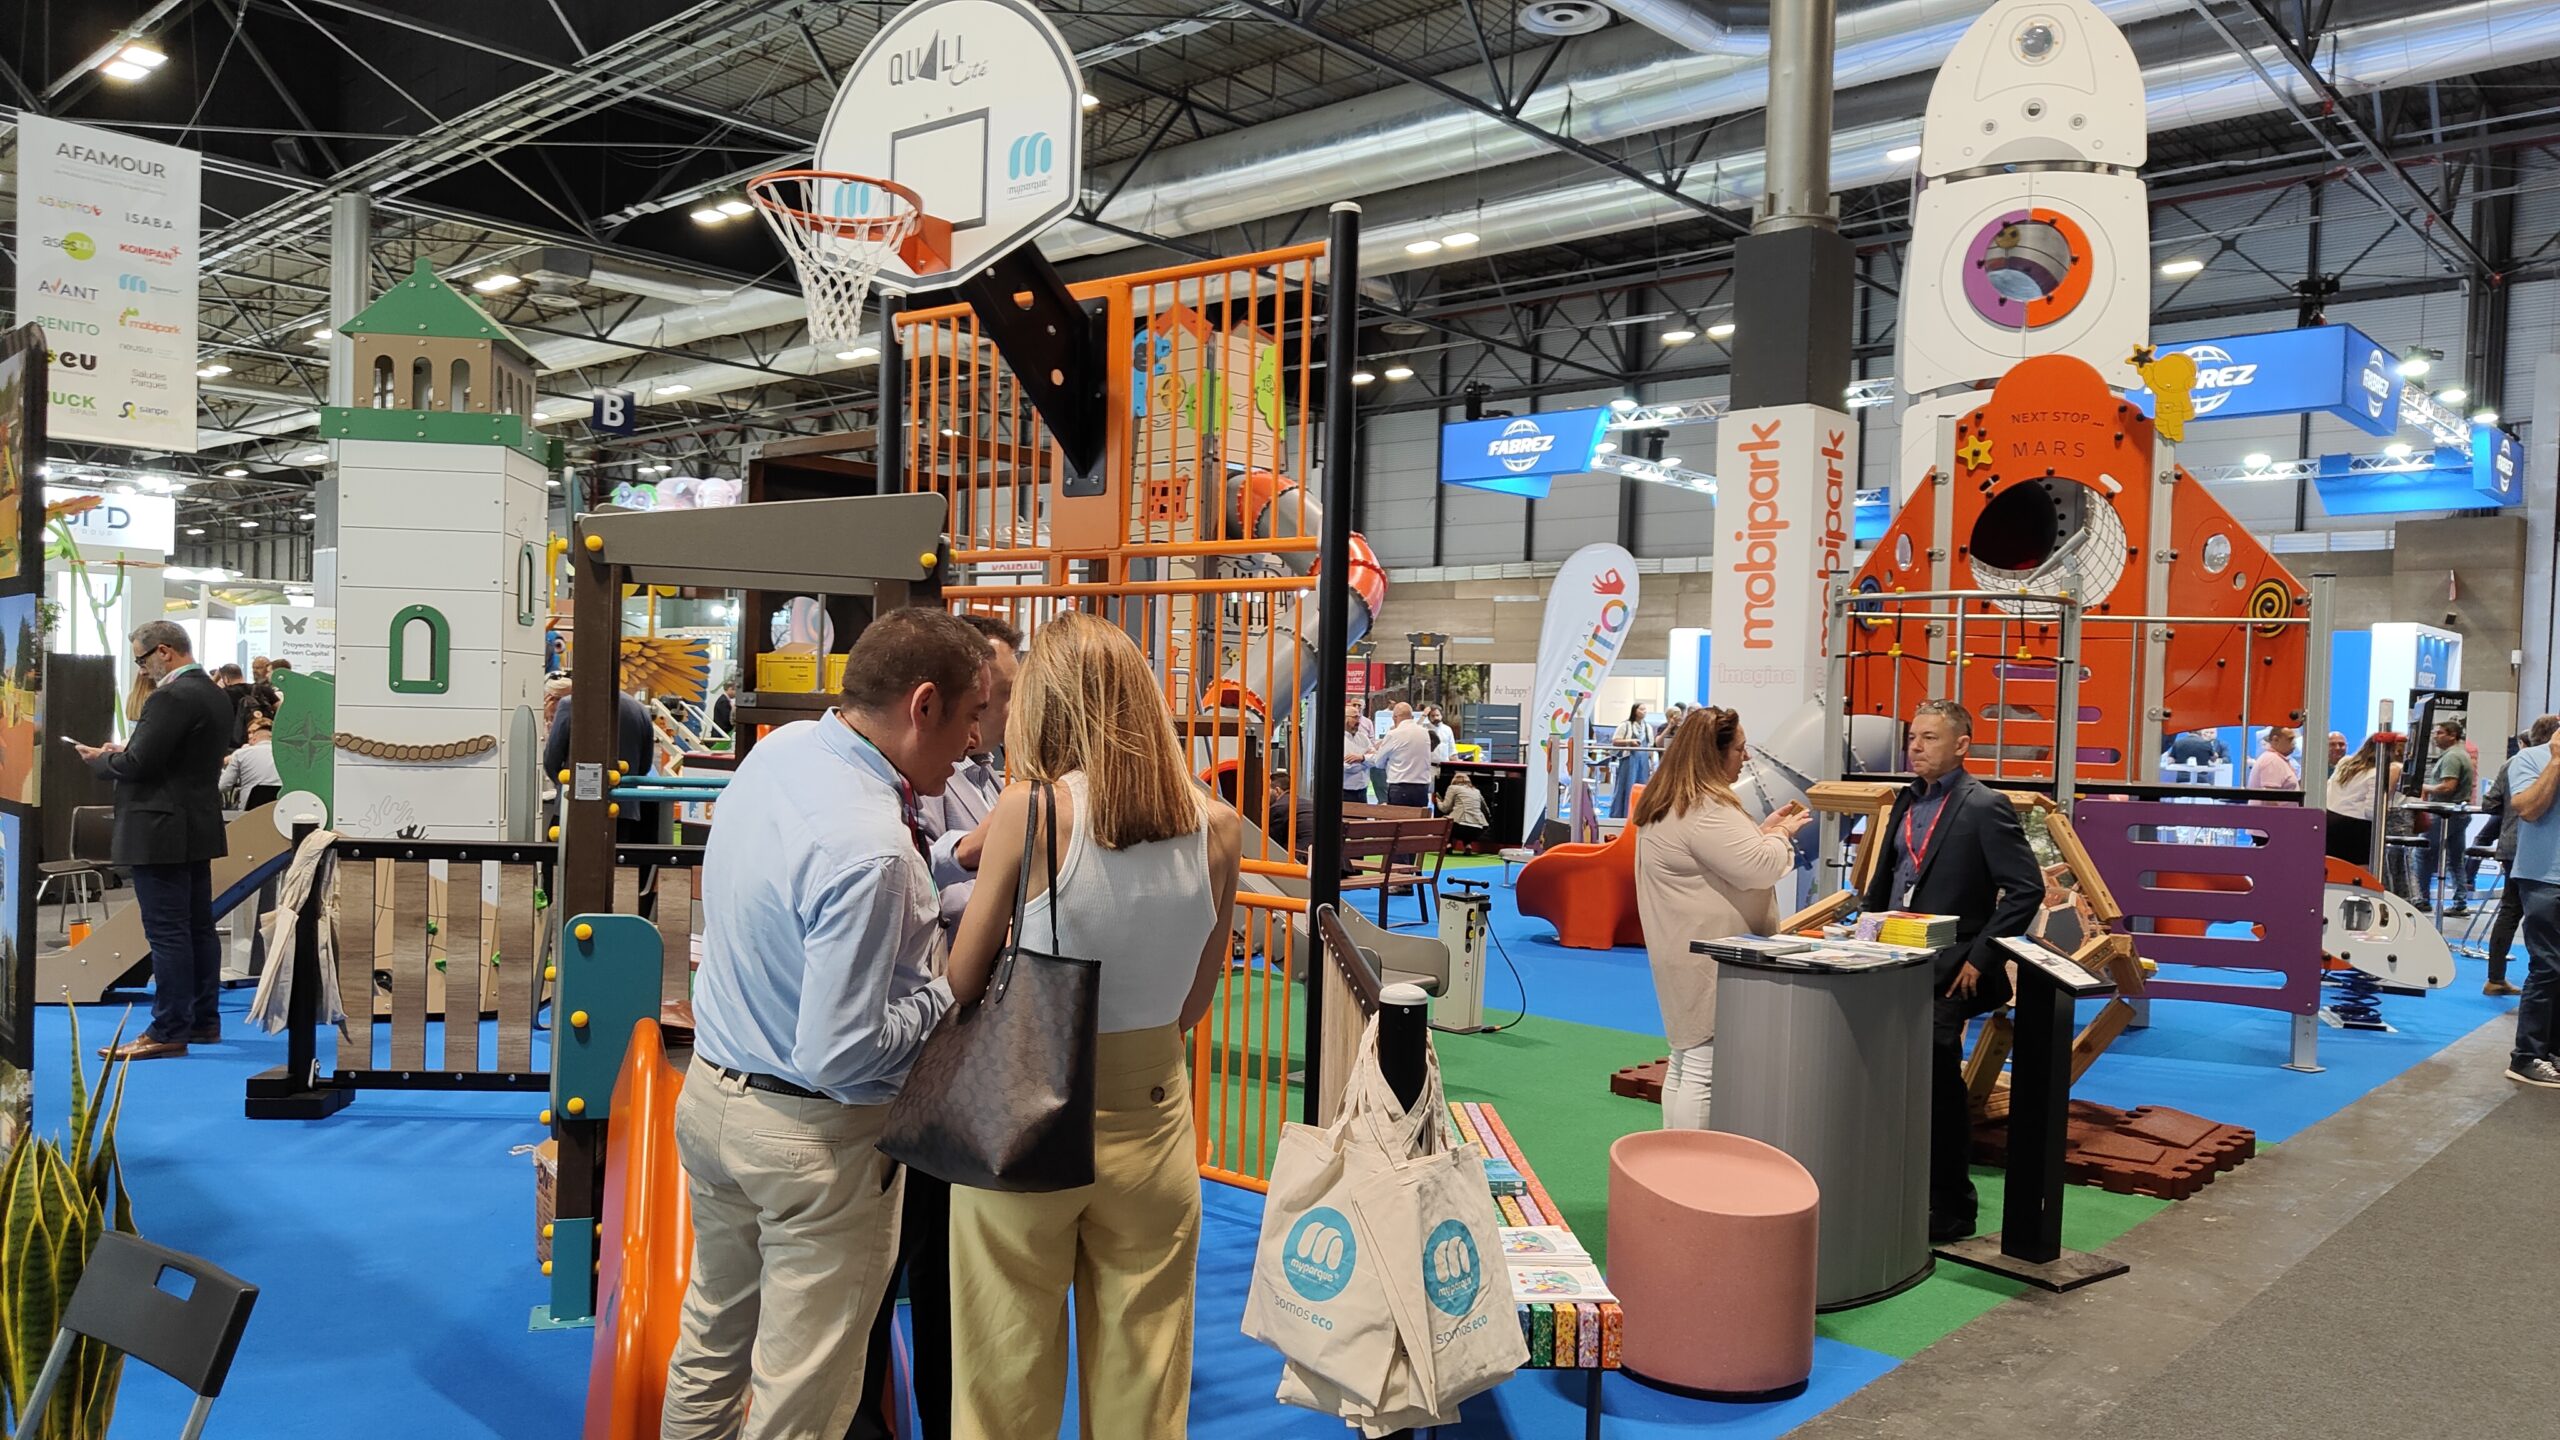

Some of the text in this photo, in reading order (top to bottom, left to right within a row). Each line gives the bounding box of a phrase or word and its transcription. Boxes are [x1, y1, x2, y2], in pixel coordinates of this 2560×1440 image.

[55, 142, 166, 180] AFAMOUR
[125, 211, 176, 231] ISABA
[36, 315, 101, 336] BENITO
[47, 390, 97, 409] UCK
[601, 393, 625, 427] B
[2011, 411, 2048, 424] NEXT
[1487, 434, 1556, 457] FABREZ
[2012, 440, 2086, 458] MARS
[1733, 418, 1790, 649] mobipark
[1538, 620, 1595, 730] INDUSTRIAS
[1540, 599, 1631, 757] GAPITO
[1718, 663, 1796, 688] Imagina
[1274, 1294, 1333, 1331] somos eco
[1435, 1314, 1488, 1345] somos eco
